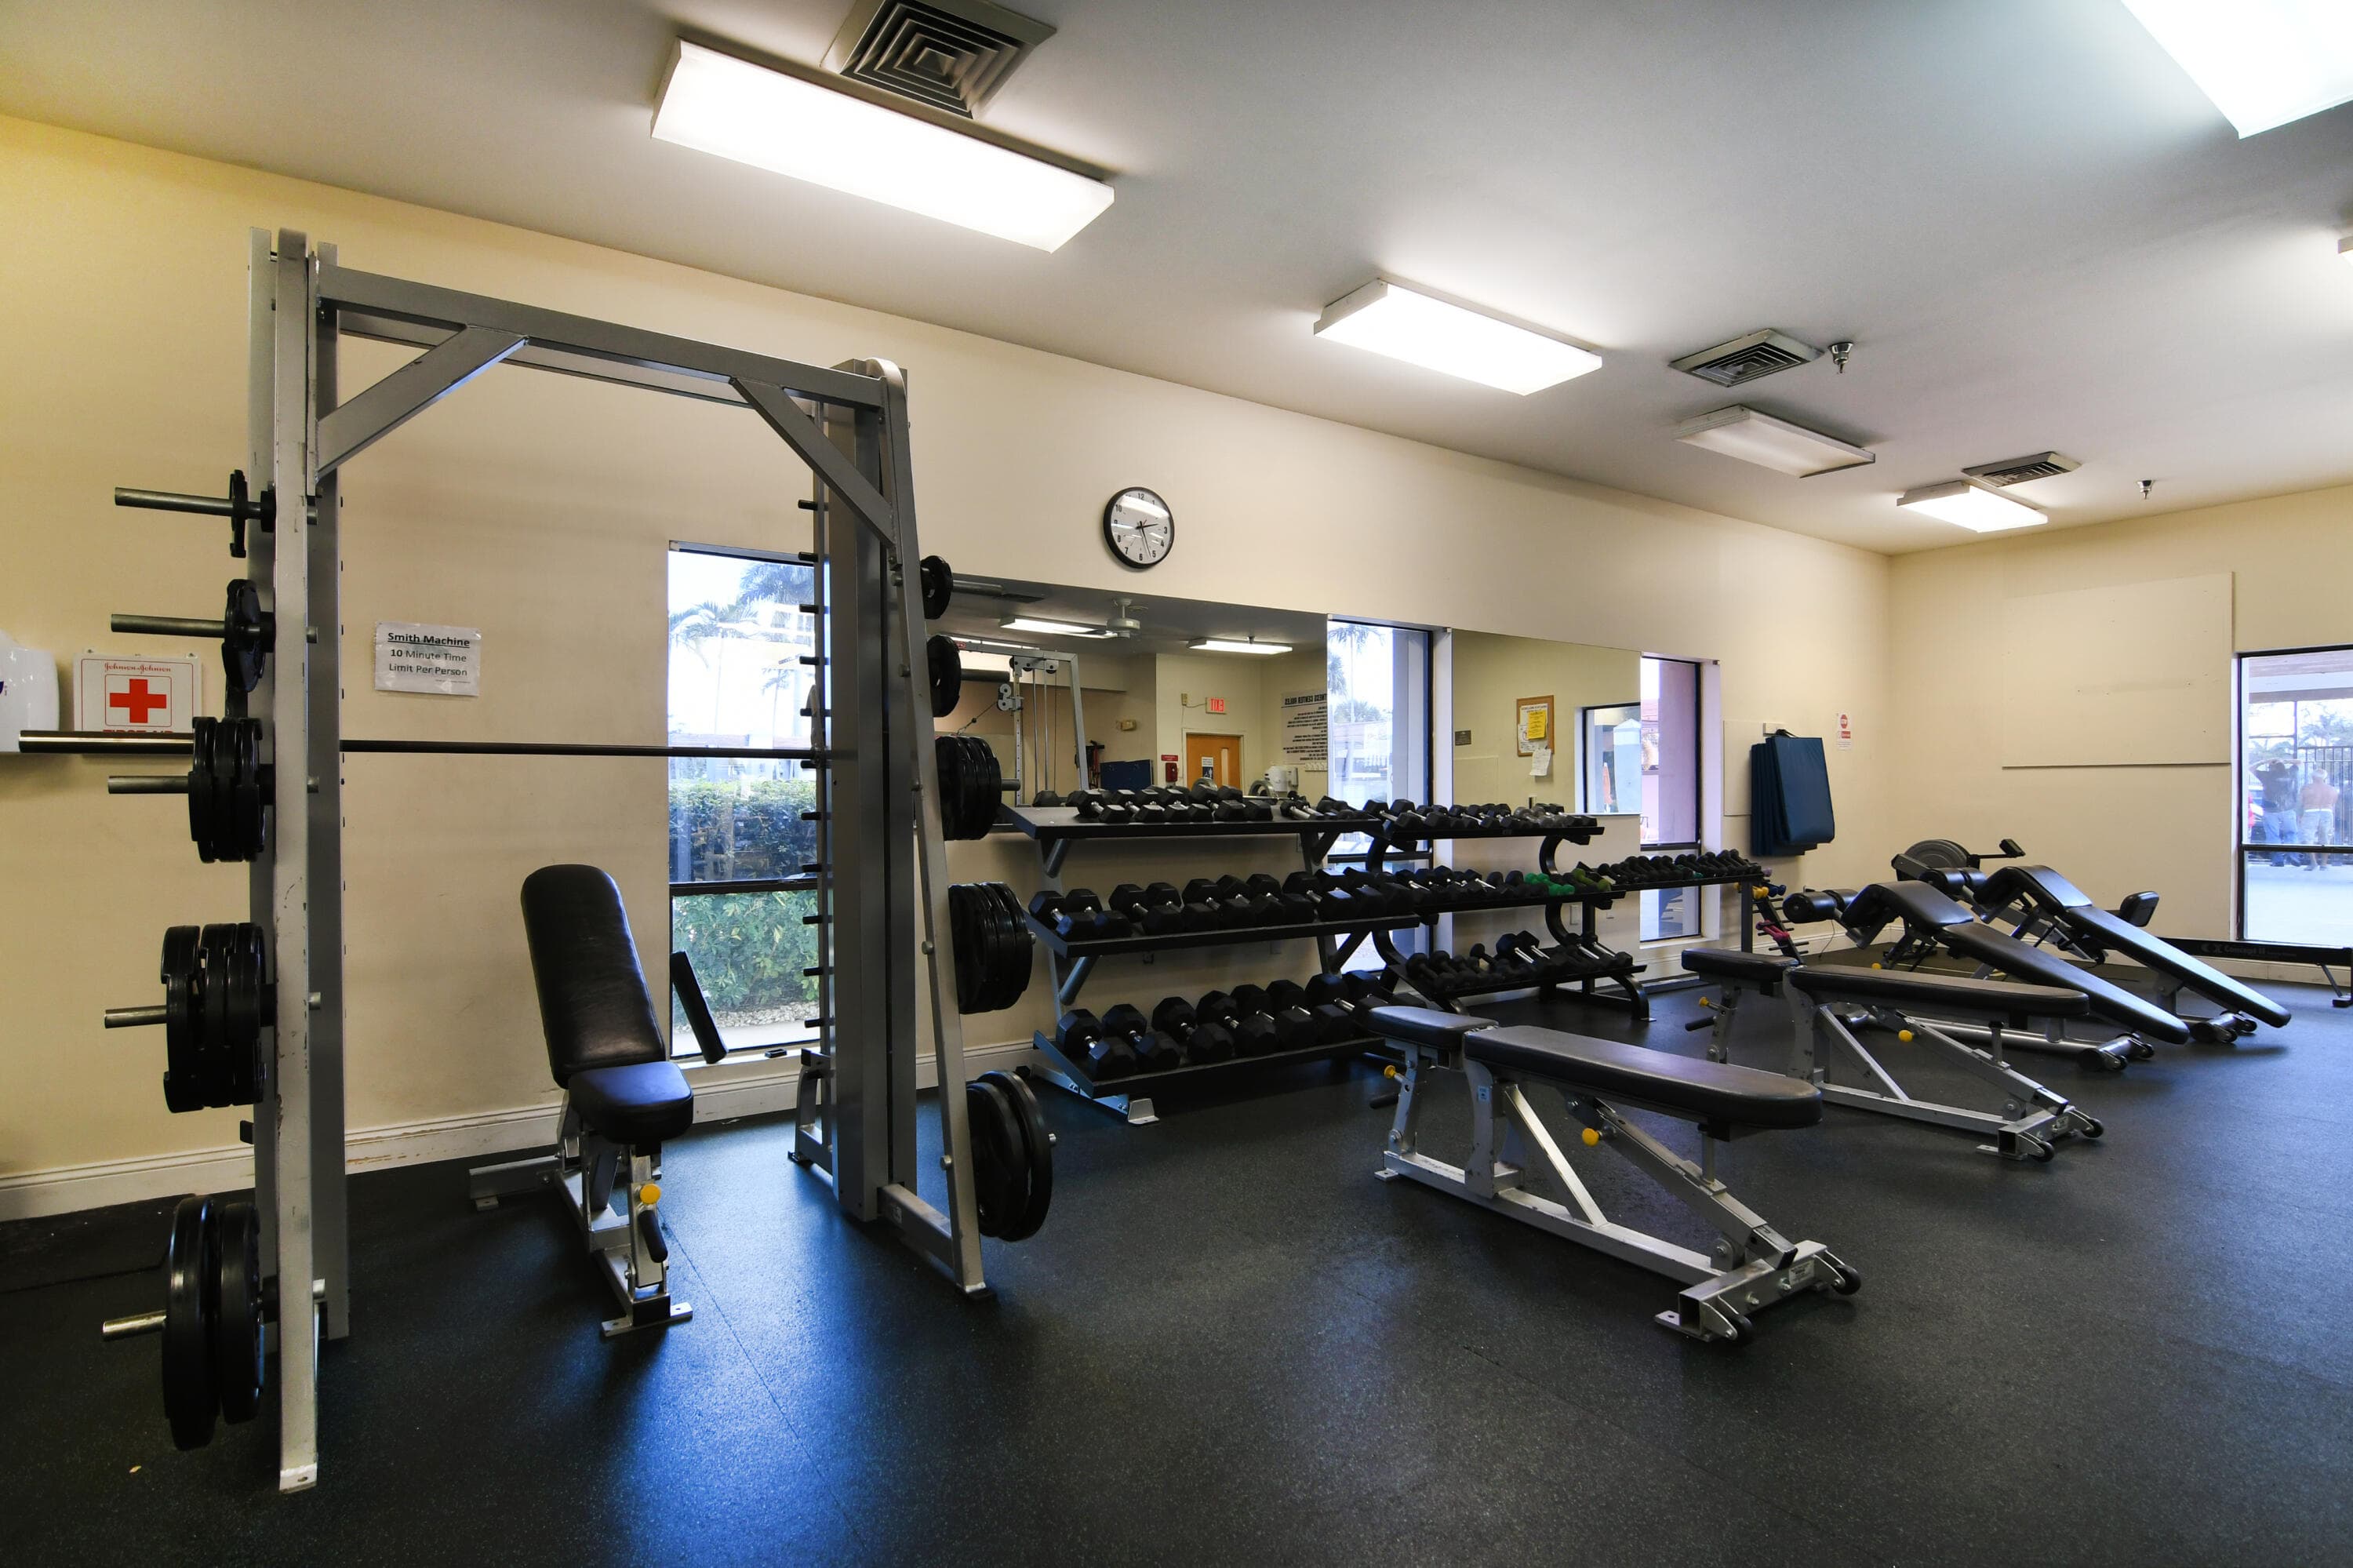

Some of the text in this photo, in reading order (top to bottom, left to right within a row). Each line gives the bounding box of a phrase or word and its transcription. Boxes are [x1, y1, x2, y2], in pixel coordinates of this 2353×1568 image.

[387, 632, 471, 646] Smith Machine
[391, 649, 467, 662] 10 Minute Time
[389, 664, 467, 676] Limit Per Person
